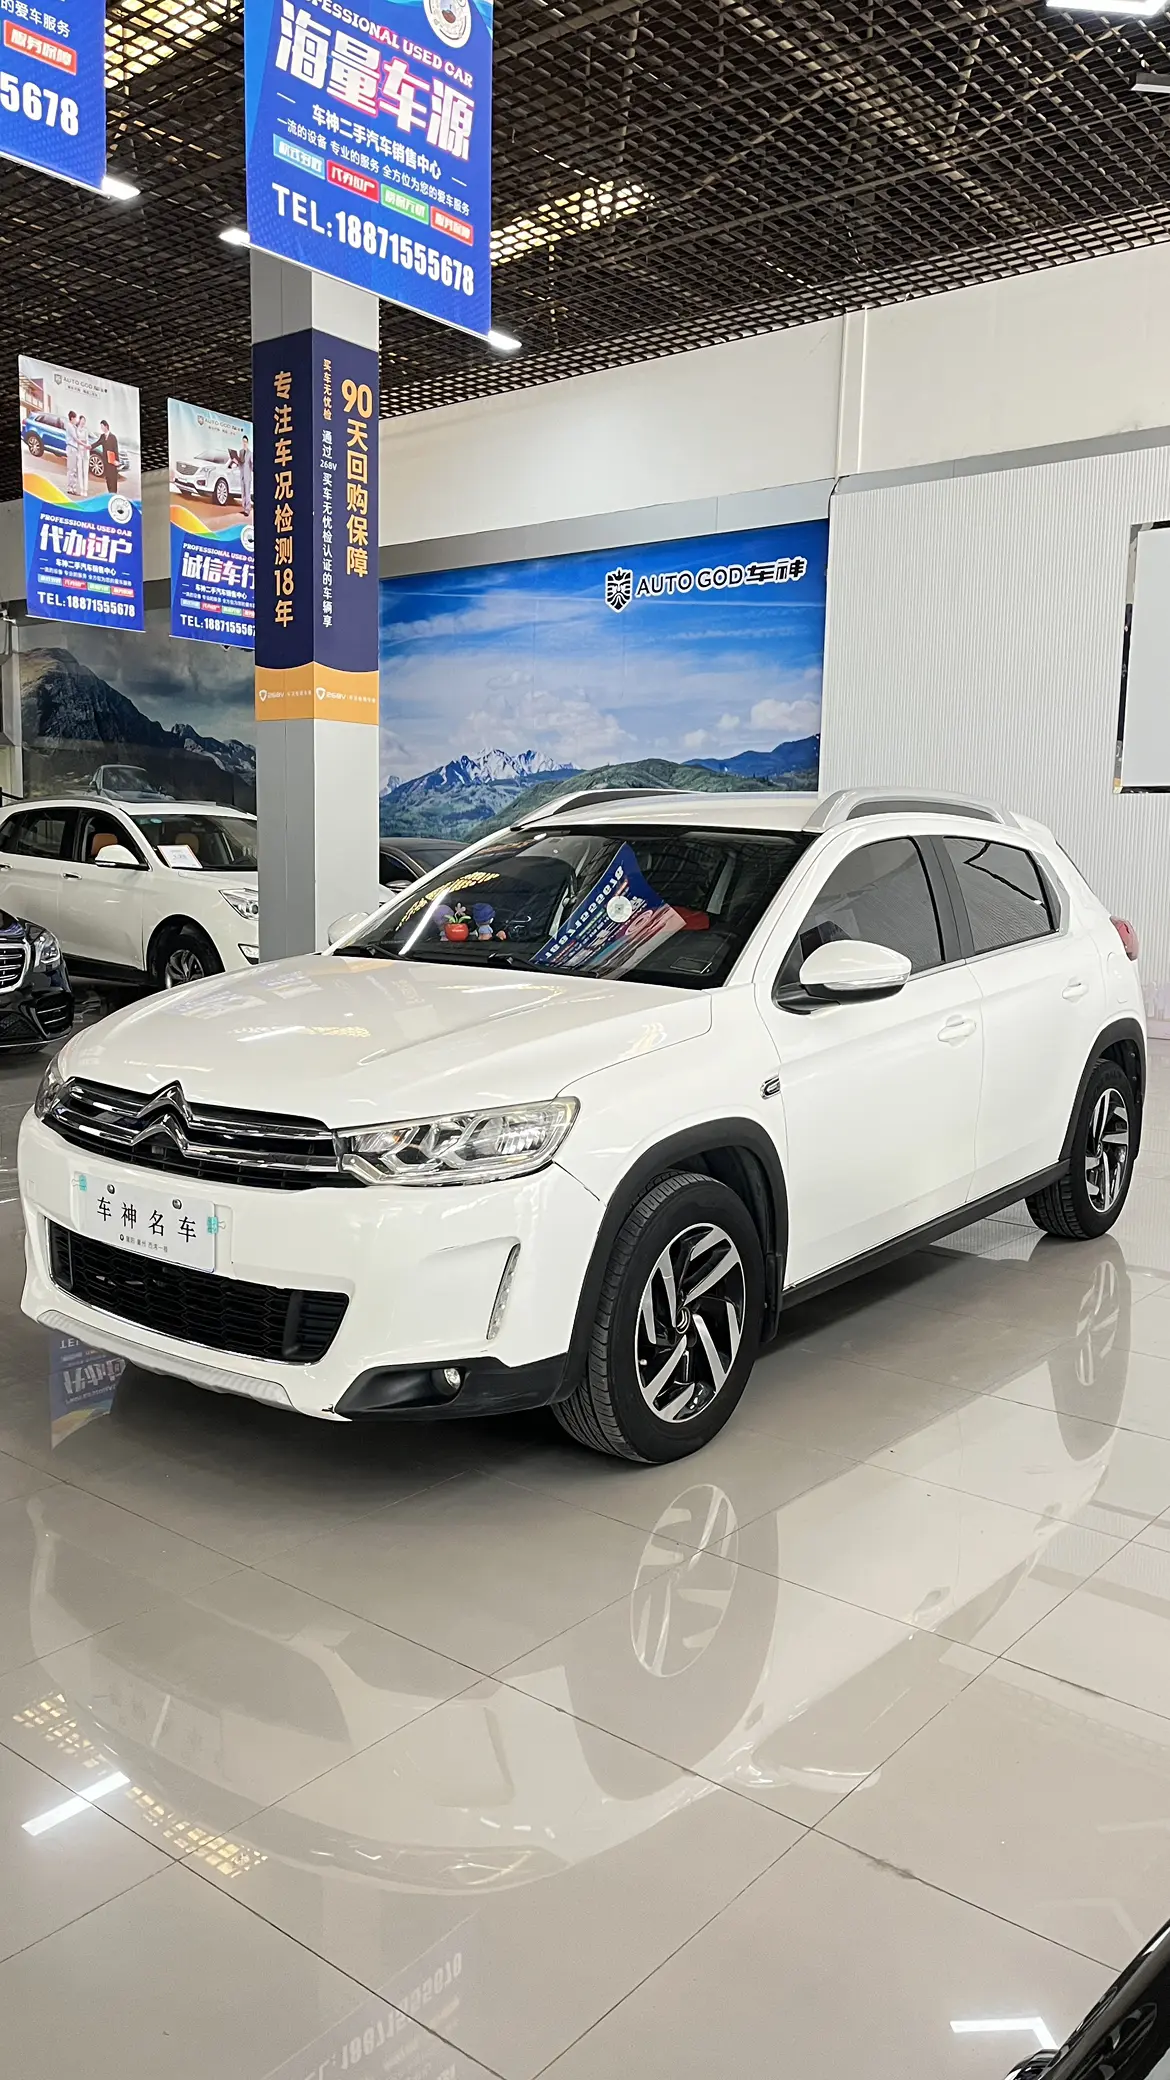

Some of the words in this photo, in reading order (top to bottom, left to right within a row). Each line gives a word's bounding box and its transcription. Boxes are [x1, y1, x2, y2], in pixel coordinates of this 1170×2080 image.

[306, 0, 400, 49] ESSIONAL
[402, 38, 442, 70] USED
[444, 60, 473, 88] CAR
[275, 0, 475, 161] 海量车源
[312, 104, 442, 180] 车神二手汽车销售中心
[272, 182, 475, 297] TEL:18871555678
[40, 513, 96, 530] PROFESSIONAL
[96, 524, 116, 534] USED
[117, 528, 132, 537] CAR
[40, 523, 133, 563] 代办过户
[182, 552, 255, 589] 诚信车行
[183, 543, 230, 558] PROFESSIONAL
[637, 574, 692, 596] AUTO
[698, 567, 743, 588] GOD
[746, 558, 806, 582] 车神
[37, 591, 136, 618] TEL:18871555678
[97, 1196, 197, 1243] 车神名车
